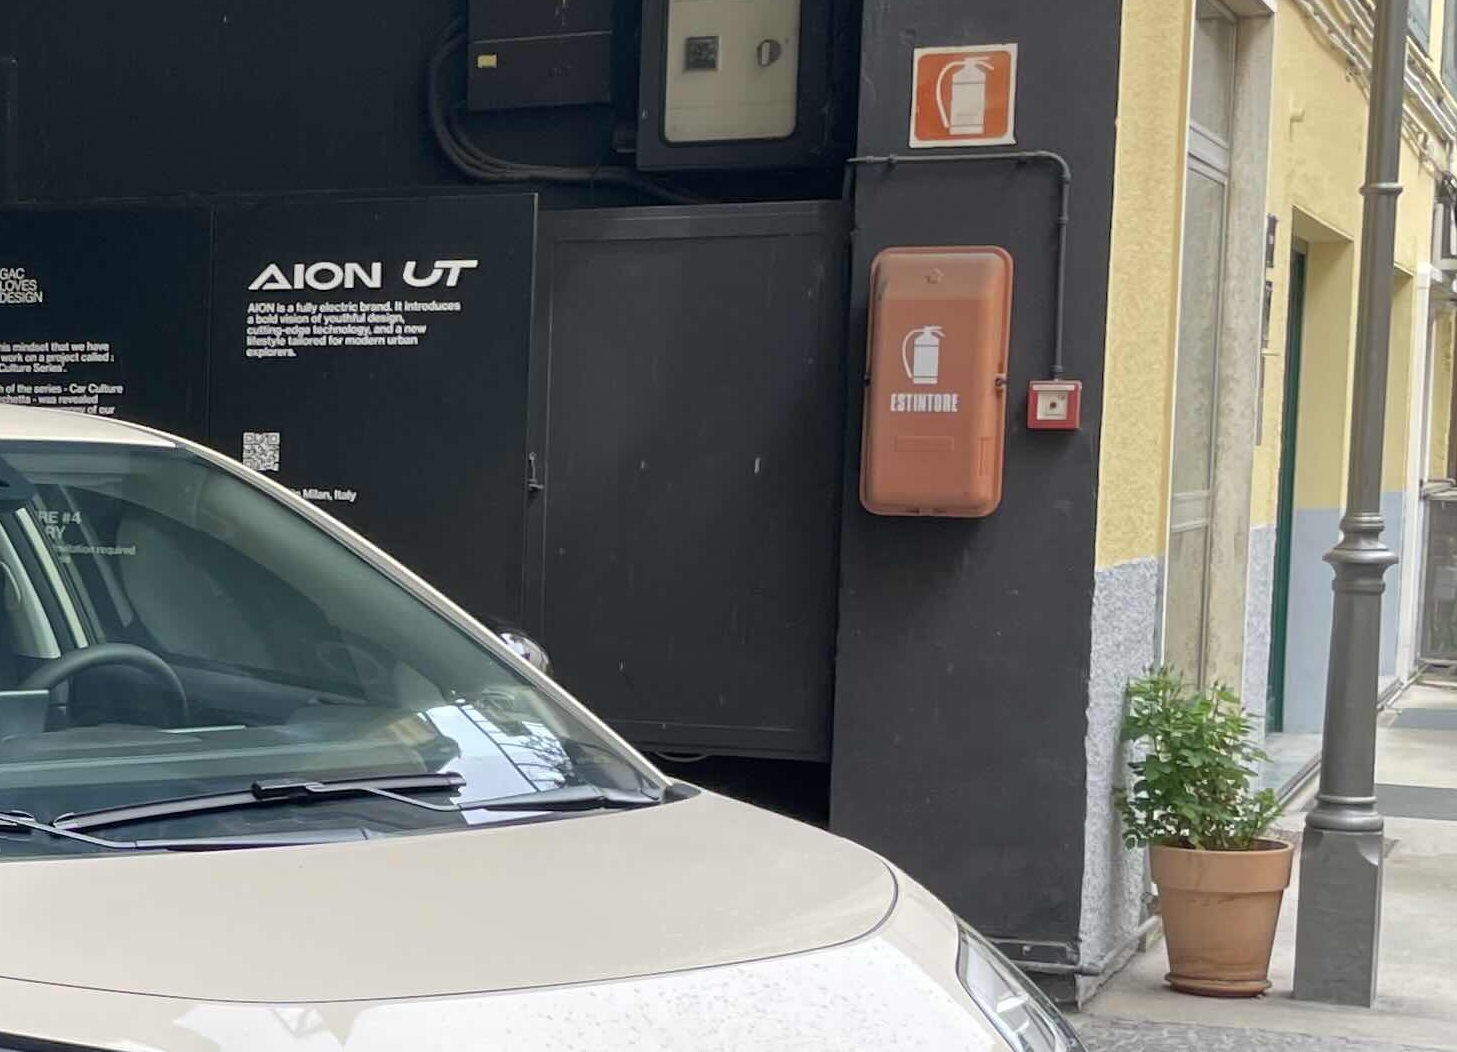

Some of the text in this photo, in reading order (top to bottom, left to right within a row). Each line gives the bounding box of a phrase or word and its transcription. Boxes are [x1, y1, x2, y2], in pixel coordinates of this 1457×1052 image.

[0, 268, 26, 280] GAC
[247, 259, 479, 290] AION UT
[0, 279, 37, 292] LOVES
[0, 291, 43, 304] DESIGN
[248, 302, 274, 313] AION
[276, 302, 285, 313] is
[287, 304, 294, 313] a
[296, 301, 317, 314] fully
[319, 301, 358, 312] electric
[360, 301, 392, 312] brand.
[404, 300, 461, 312] introduces
[247, 312, 405, 326] a bold vision of youthful design,
[247, 324, 310, 338] cutting-edge
[373, 323, 393, 335] and
[395, 325, 402, 334] a
[404, 325, 427, 334] new
[13, 342, 49, 352] mindset
[51, 342, 69, 352] that
[71, 343, 85, 352] we
[87, 341, 110, 352] have
[247, 335, 419, 348] lifestyle tailored for modern urban
[1, 353, 23, 362] work
[38, 354, 45, 362] a
[46, 352, 79, 365] project
[81, 352, 109, 362] called
[246, 346, 297, 358] explorers.
[5, 384, 15, 394] of
[17, 384, 32, 393] the
[34, 384, 62, 393] series
[69, 383, 86, 393] Car
[87, 383, 123, 393] Culture
[890, 393, 959, 413] ESTINTORE
[303, 489, 332, 500] Milan,
[334, 489, 357, 502] Italy
